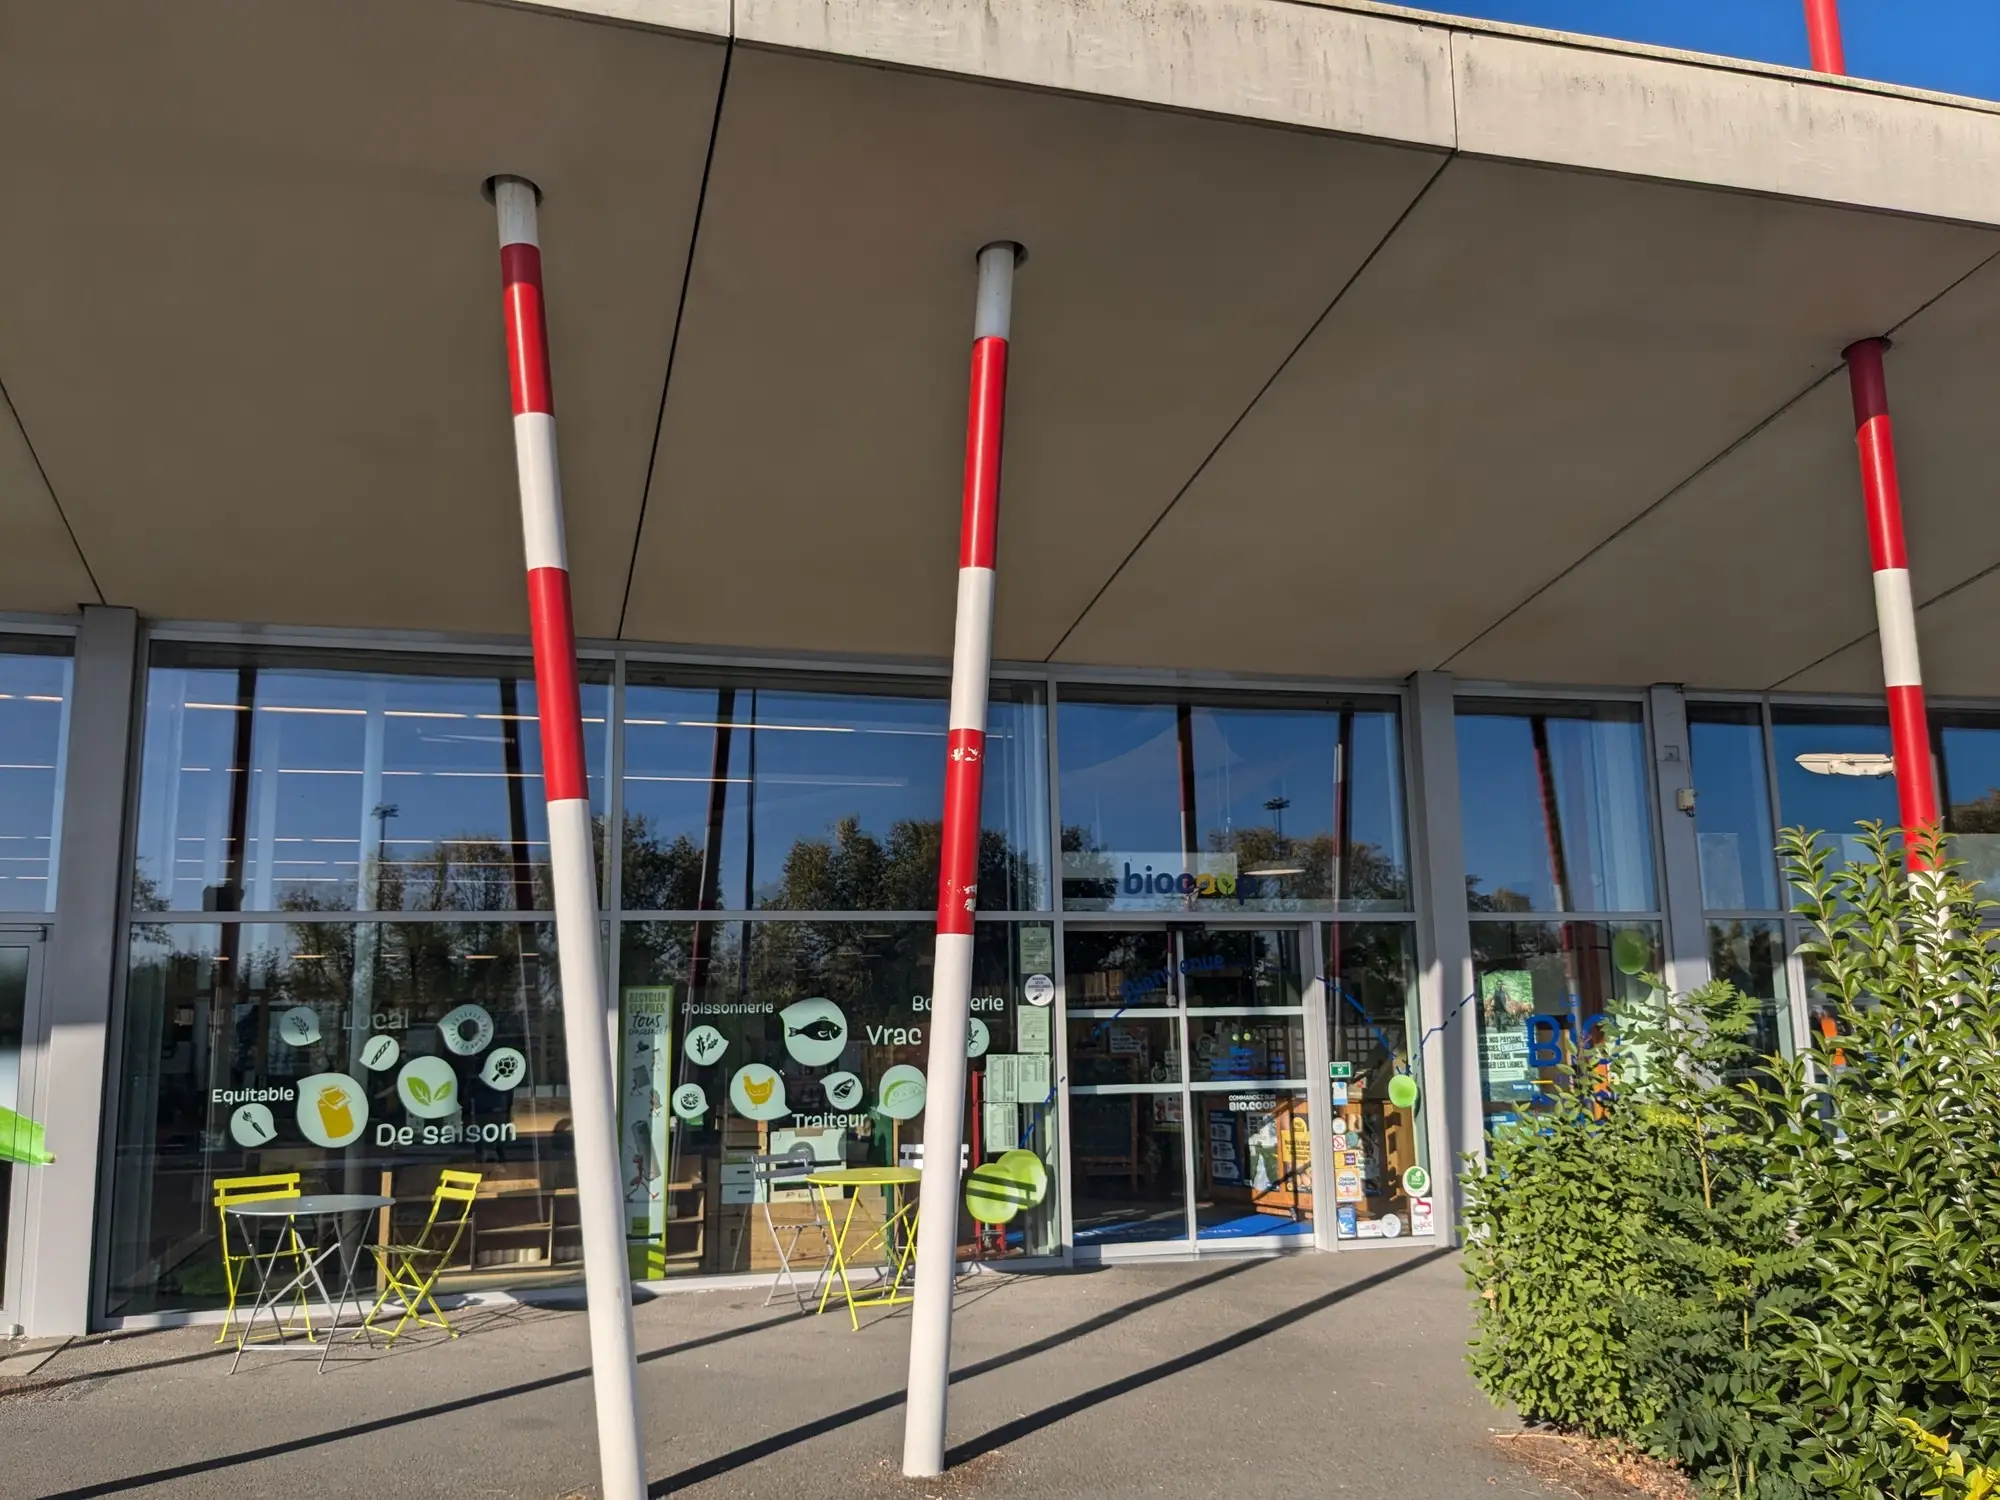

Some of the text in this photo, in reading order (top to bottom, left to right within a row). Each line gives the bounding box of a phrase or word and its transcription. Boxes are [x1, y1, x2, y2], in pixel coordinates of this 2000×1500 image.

[1123, 861, 1256, 906] biocoop
[681, 1002, 774, 1015] Poissonnerie
[343, 1009, 409, 1030] Local
[865, 1025, 922, 1046] Vrac
[212, 1087, 295, 1105] Equitable
[1228, 1101, 1277, 1112] BIO.COOP
[792, 1113, 868, 1129] Traiteur
[376, 1121, 517, 1147] De saison
